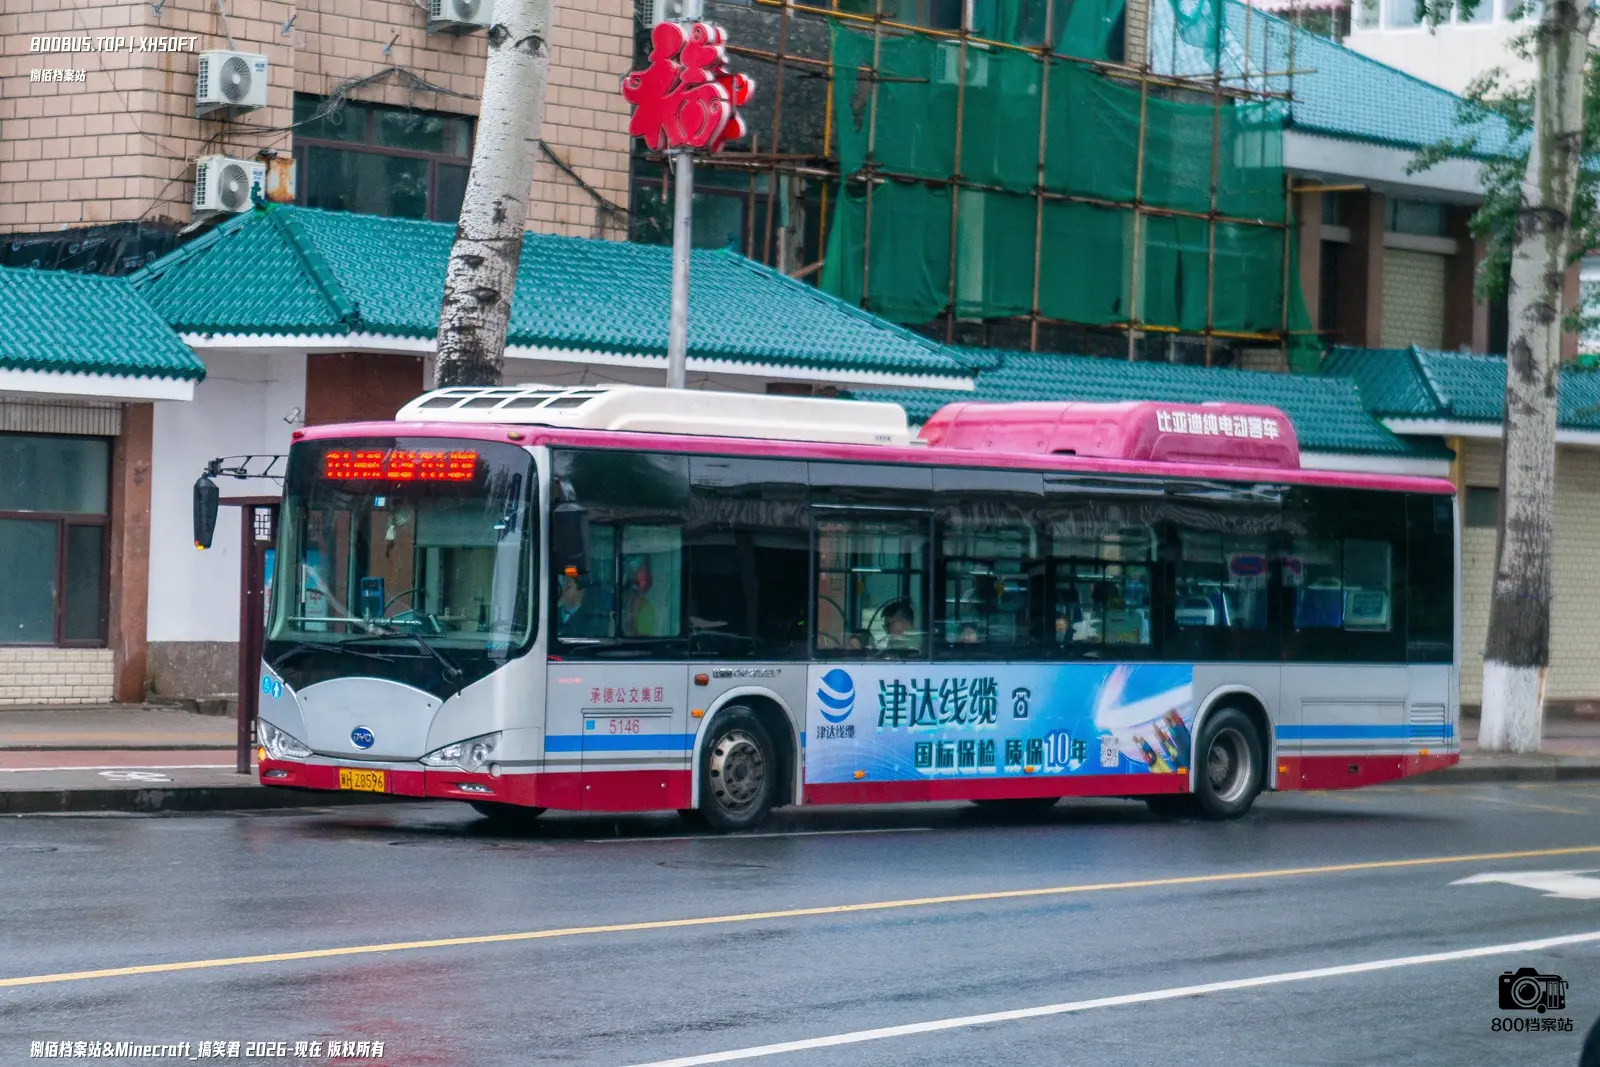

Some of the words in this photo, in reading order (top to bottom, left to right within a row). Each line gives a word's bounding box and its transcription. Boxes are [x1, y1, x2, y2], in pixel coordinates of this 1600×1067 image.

[1156, 409, 1280, 440] 比亚迪纯电动客车
[590, 687, 664, 704] 承德公交集团
[876, 676, 999, 729] 津达线缆
[609, 719, 640, 734] 5146
[816, 725, 856, 740] 津达线缆
[914, 740, 996, 769] 国标保检
[1005, 731, 1088, 767] 质保10年
